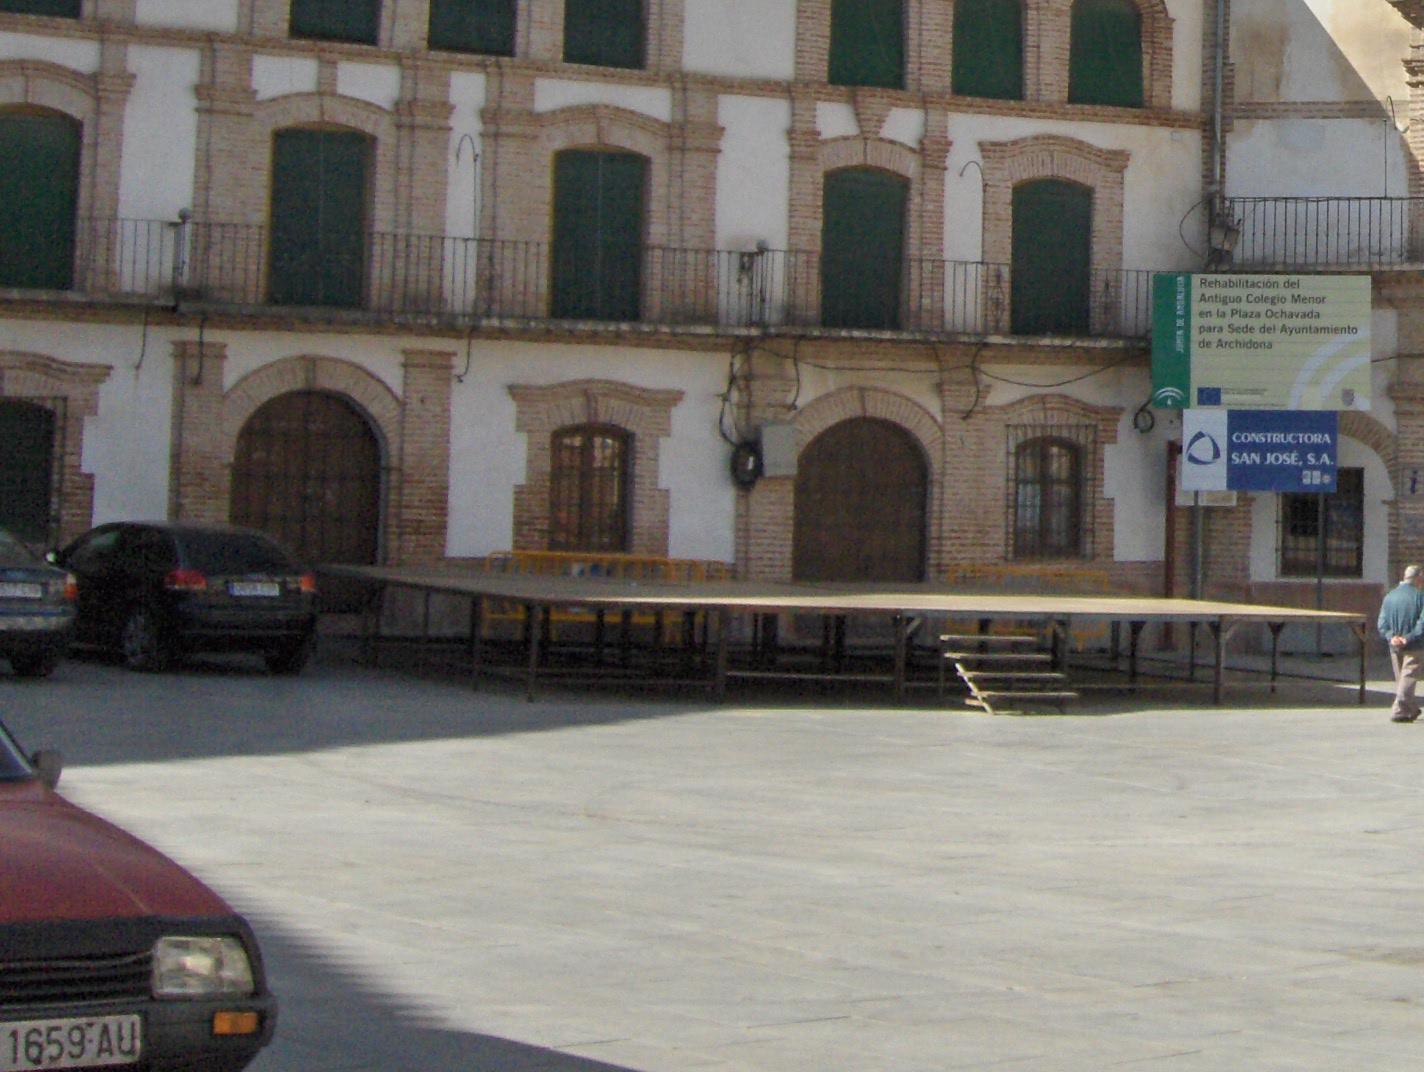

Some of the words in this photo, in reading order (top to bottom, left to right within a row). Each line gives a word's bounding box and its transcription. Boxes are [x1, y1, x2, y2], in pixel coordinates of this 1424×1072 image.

[1199, 278, 1279, 289] Rehabilitación
[1283, 279, 1300, 289] del
[1198, 293, 1242, 306] Antiguo
[1246, 293, 1287, 306] Colegio
[1291, 294, 1327, 304] Menor
[1198, 310, 1212, 319] en
[1216, 308, 1226, 319] la
[1230, 308, 1261, 319] Plaza
[1265, 309, 1320, 320] Ochavada
[1176, 319, 1184, 327] DE
[1198, 325, 1224, 336] para
[1227, 323, 1256, 334] Sede
[1259, 323, 1276, 334] del
[1279, 324, 1358, 337] Ayuntamiento
[1198, 338, 1213, 349] de
[1216, 338, 1273, 350] Archidona
[1232, 432, 1332, 444] CONSTRUCTORA
[1231, 452, 1260, 465] SAN
[1306, 452, 1334, 465] S.A.
